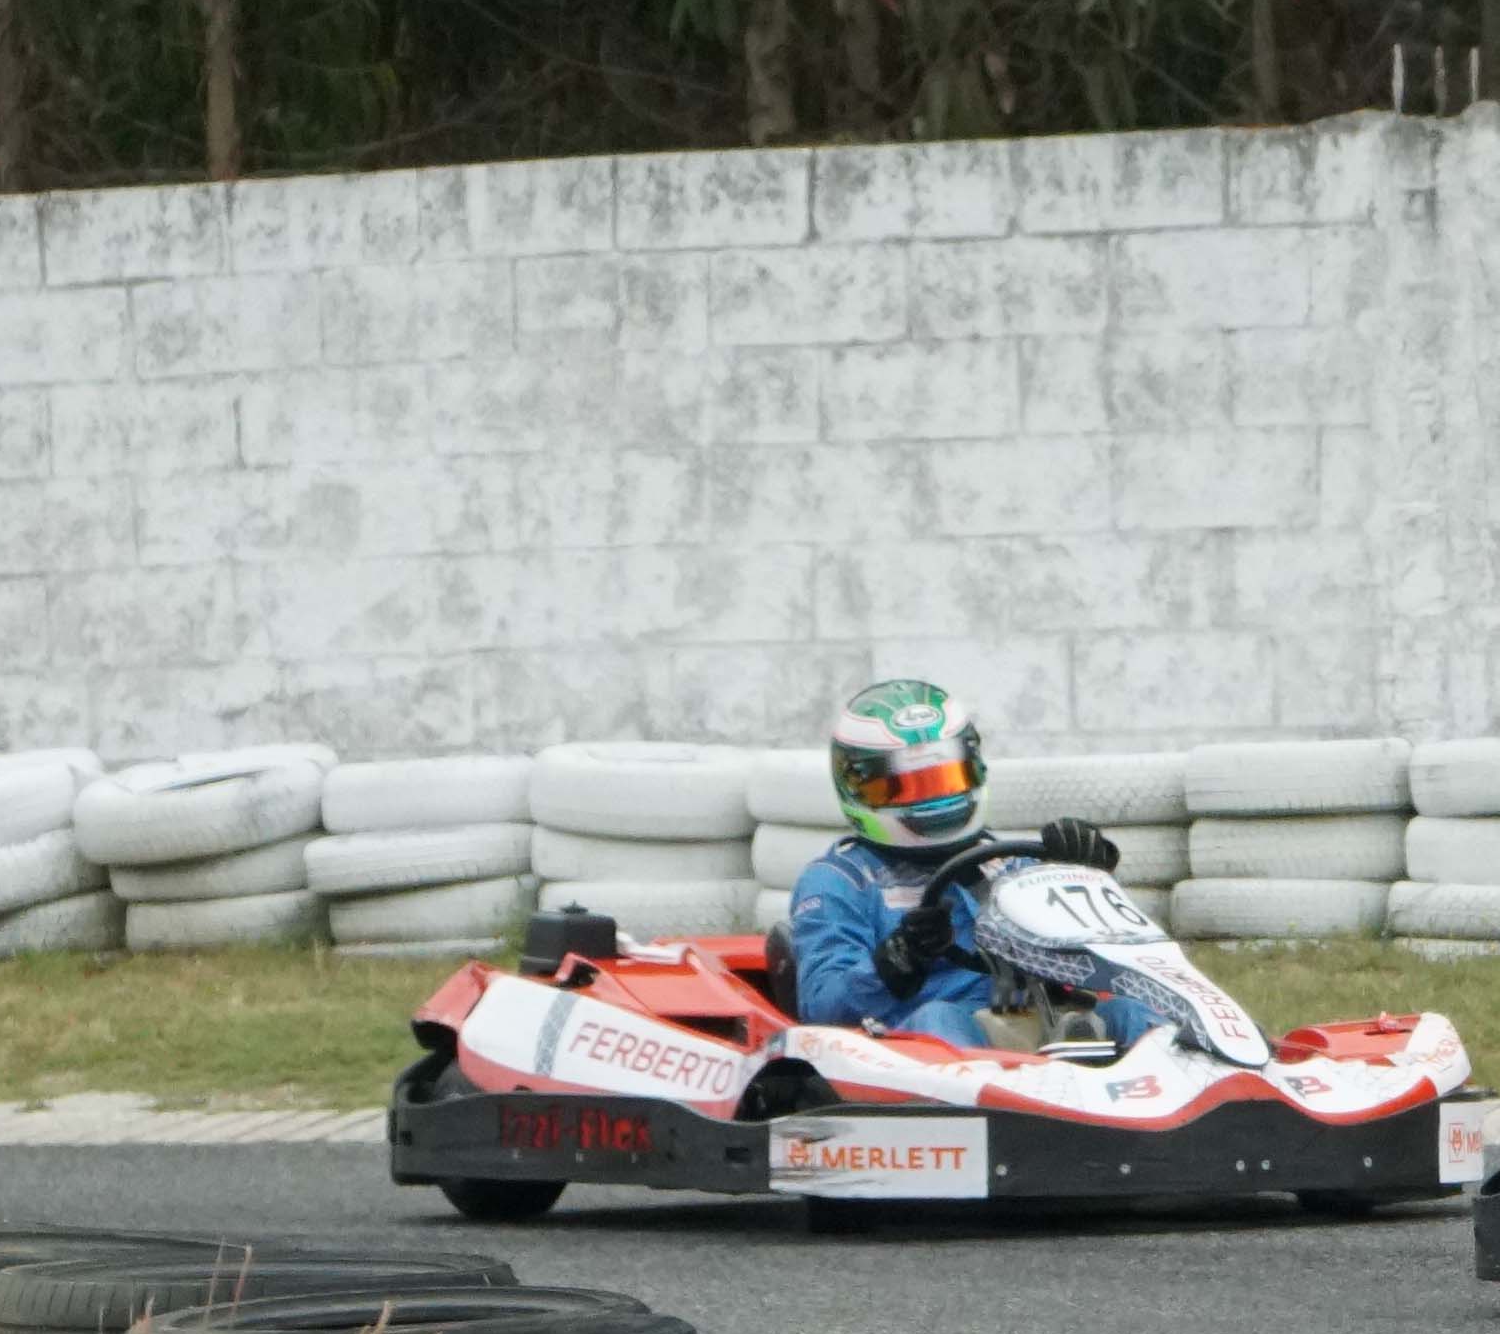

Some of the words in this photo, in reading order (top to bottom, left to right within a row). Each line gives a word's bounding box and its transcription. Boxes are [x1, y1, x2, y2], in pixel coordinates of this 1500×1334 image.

[1046, 884, 1149, 934] 176
[567, 1021, 734, 1095] FERBERTO
[821, 1146, 968, 1170] MERLETT
